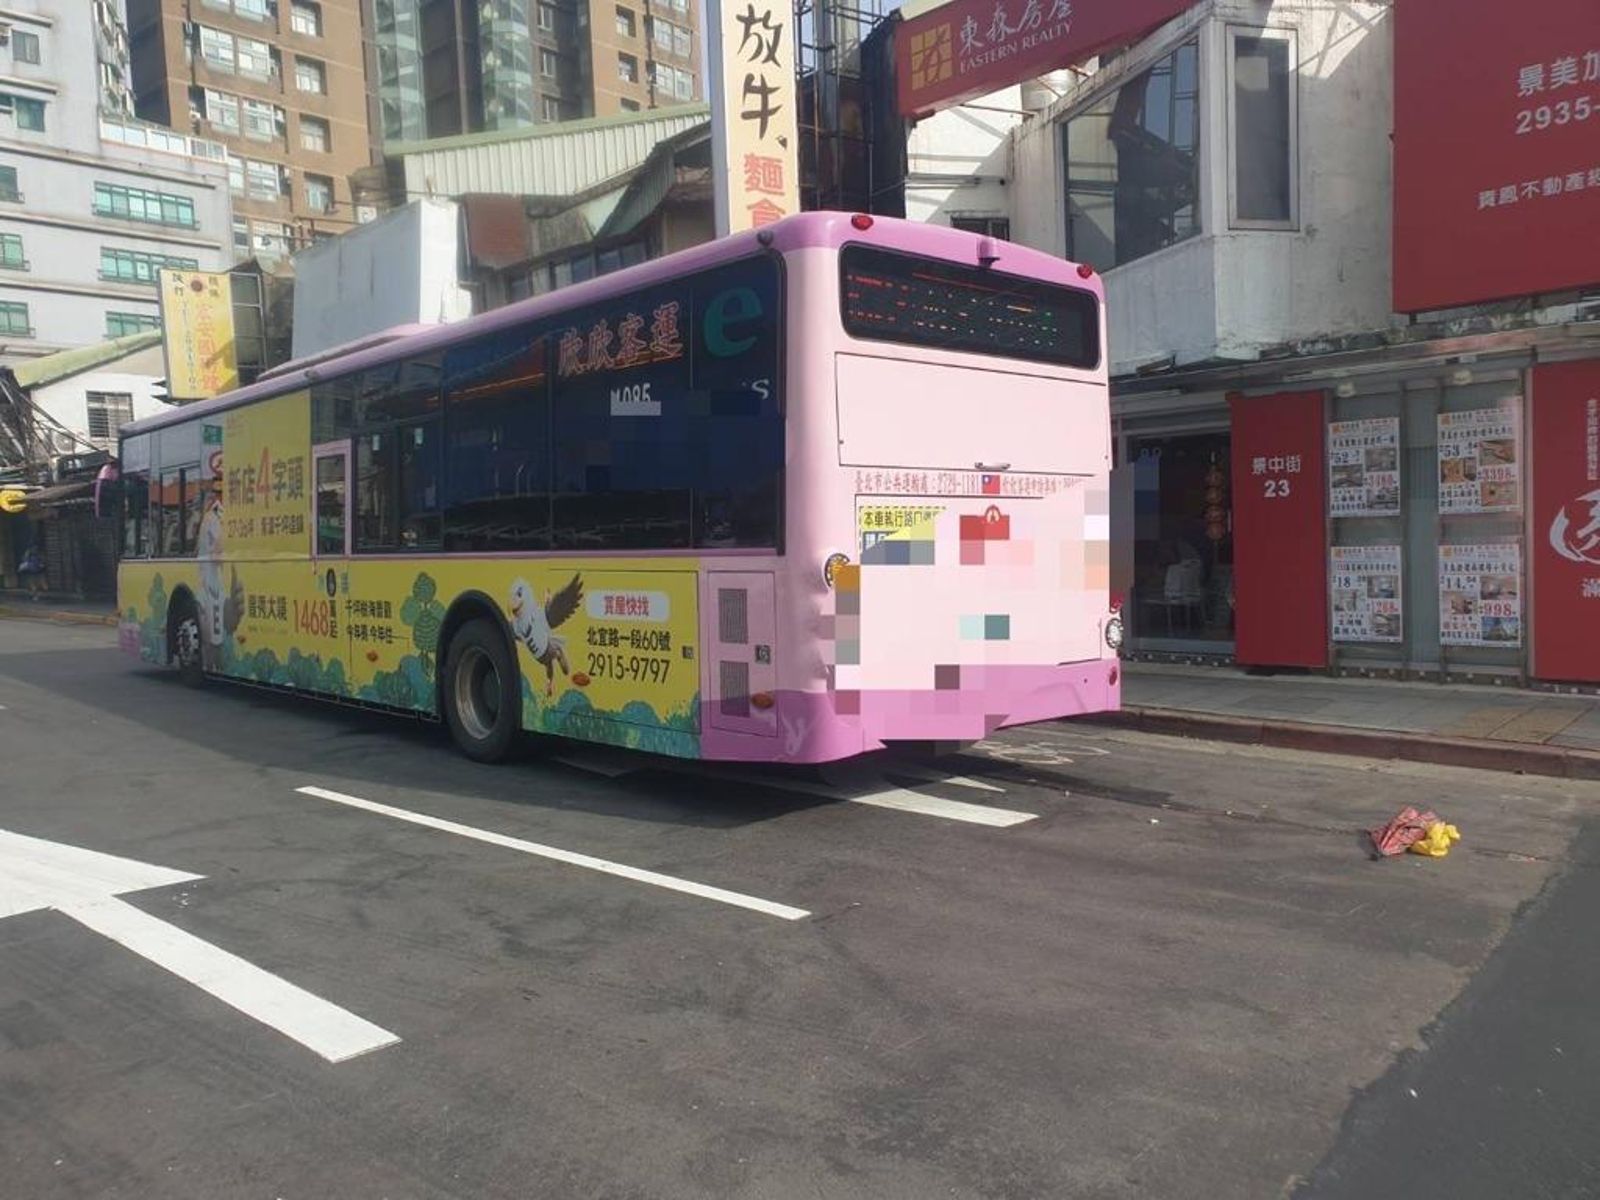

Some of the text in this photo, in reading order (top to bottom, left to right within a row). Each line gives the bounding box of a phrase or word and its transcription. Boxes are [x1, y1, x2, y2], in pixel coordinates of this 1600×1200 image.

[960, 19, 1073, 74] EASTERN REALTY
[557, 300, 684, 377] 欣欣客運
[1251, 454, 1301, 475] 景中街
[1263, 479, 1290, 498] 23
[588, 627, 671, 652] 北宜路一段60號
[588, 652, 671, 684] 2915-9797
